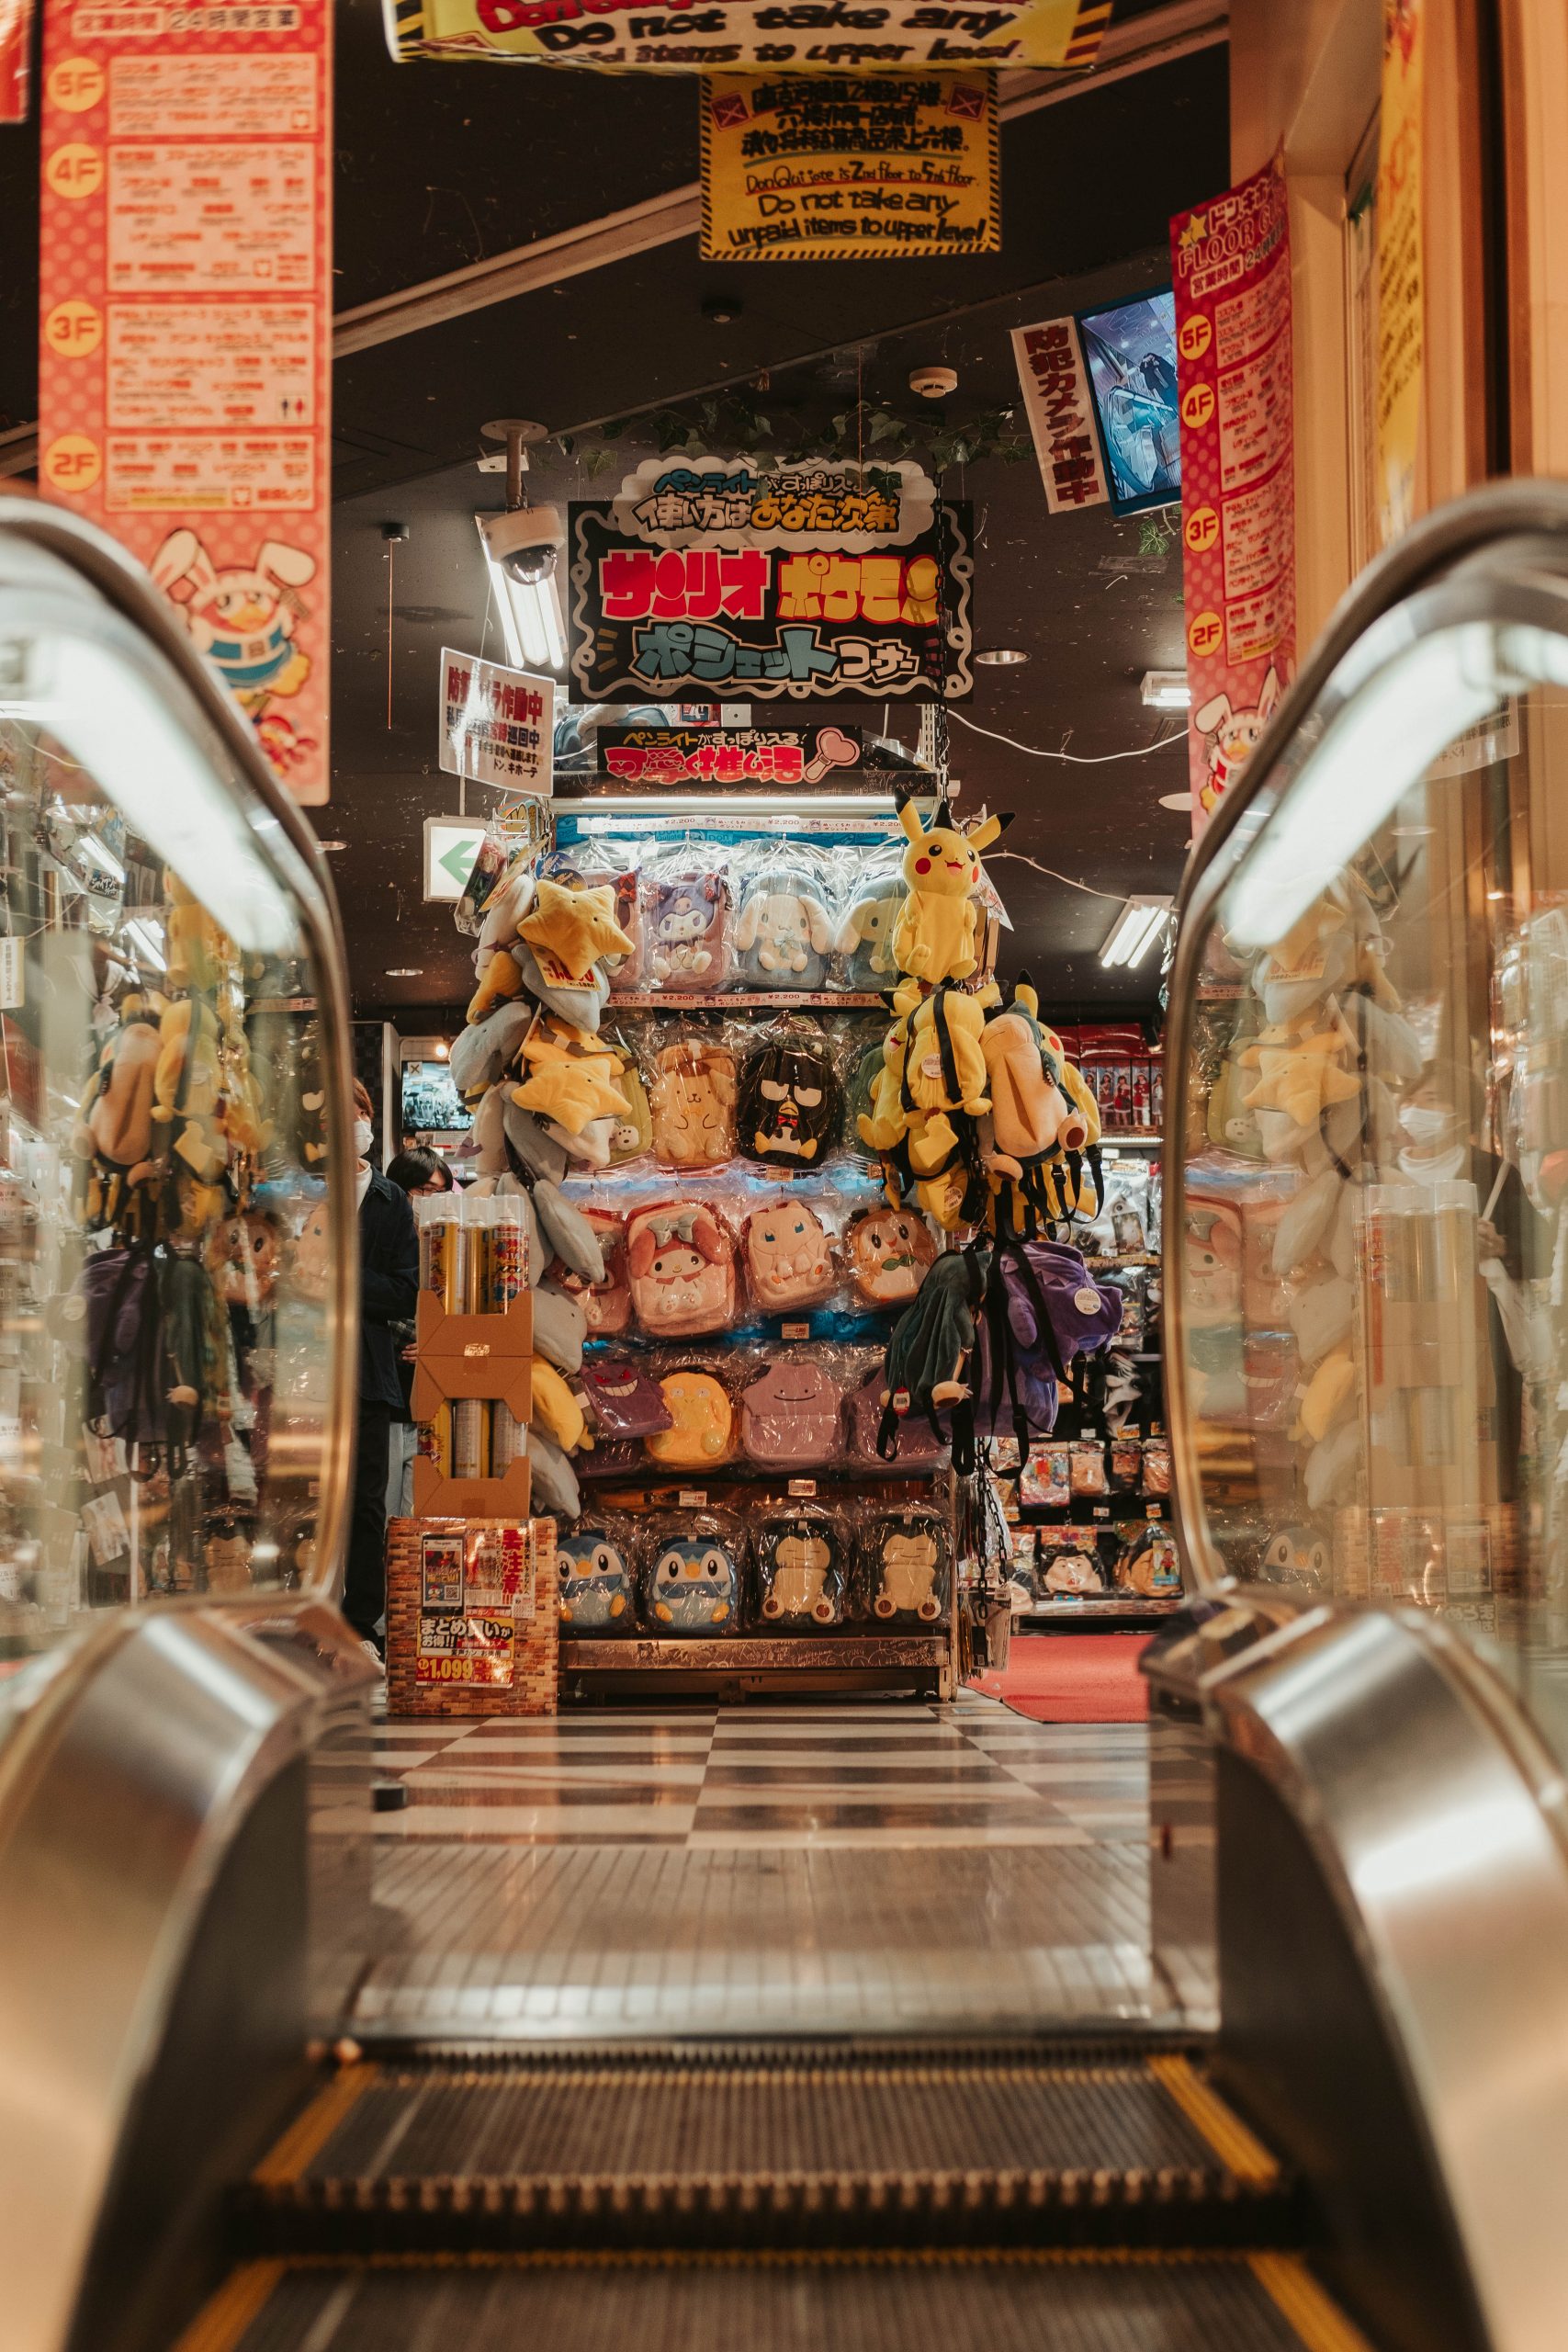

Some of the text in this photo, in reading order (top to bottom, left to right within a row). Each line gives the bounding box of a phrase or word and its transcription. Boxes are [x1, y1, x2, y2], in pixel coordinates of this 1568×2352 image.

[534, 22, 615, 51] Do
[628, 10, 728, 39] not
[752, 4, 889, 30] take
[901, 4, 1017, 40] any
[753, 43, 796, 61] to
[805, 43, 915, 65] upper
[55, 71, 98, 94] 5F
[53, 157, 98, 175] 4F
[839, 167, 850, 180] is
[849, 161, 875, 181] 2nd
[877, 160, 904, 179] floor
[909, 169, 921, 180] to
[758, 187, 959, 218] Do not take any
[728, 218, 802, 249] unpaid
[804, 217, 857, 236] items
[861, 216, 883, 235] to
[884, 220, 935, 242] upper
[1179, 218, 1255, 277] FLOOR
[52, 316, 97, 339] 3F
[1182, 322, 1210, 351] 5F
[1023, 325, 1100, 504] 防犯カメラ作動中
[1186, 390, 1213, 419] 4F
[52, 452, 96, 475] 2F
[634, 490, 901, 532] 使い方はあなた次第
[1190, 515, 1217, 542] 3F
[599, 549, 942, 627] サンリオ ポケモン
[1193, 623, 1221, 648] 2F
[422, 1635, 455, 1647] お得!!
[430, 1658, 473, 1679] 1,099
